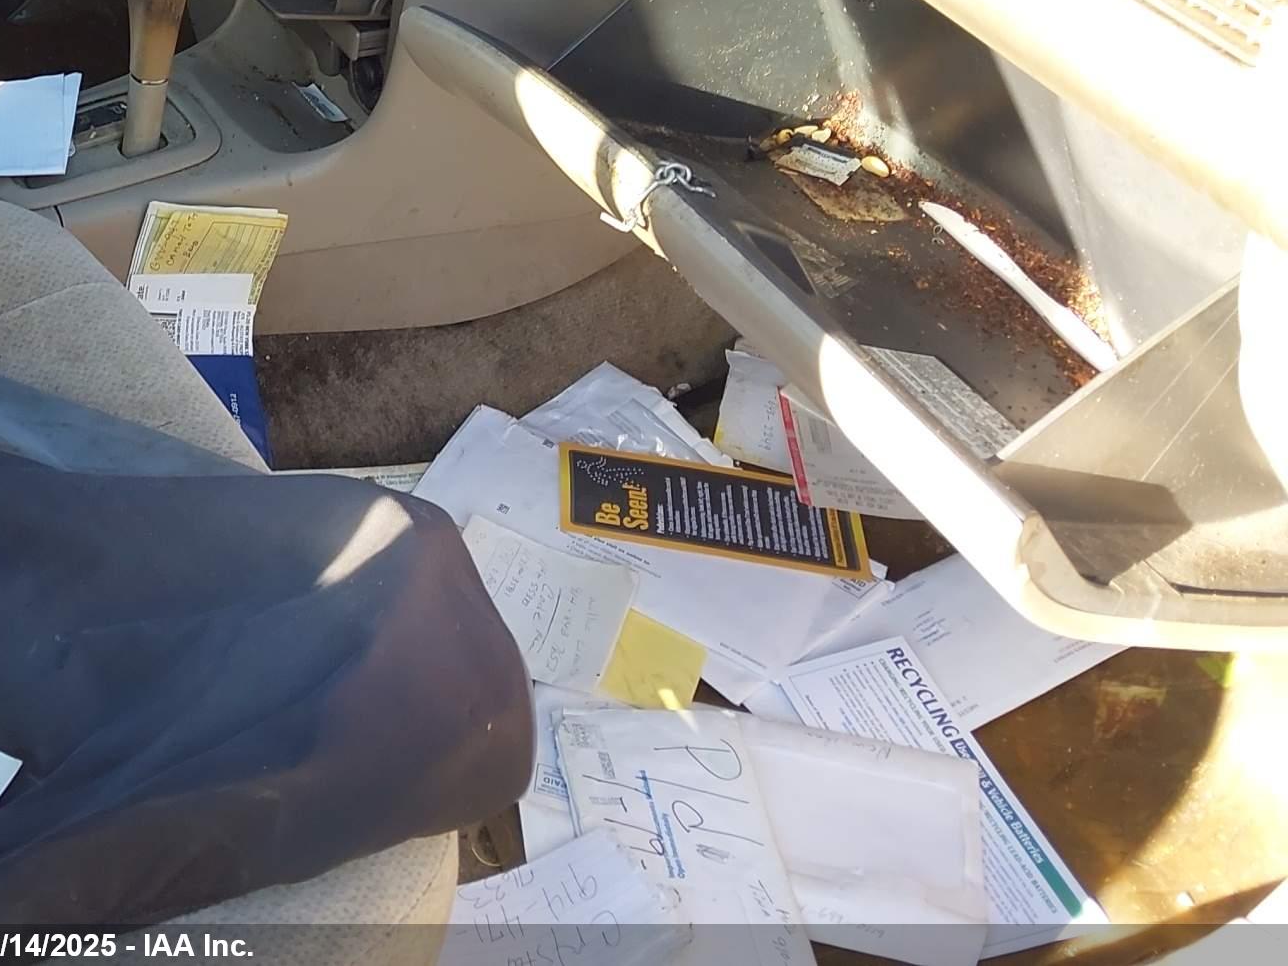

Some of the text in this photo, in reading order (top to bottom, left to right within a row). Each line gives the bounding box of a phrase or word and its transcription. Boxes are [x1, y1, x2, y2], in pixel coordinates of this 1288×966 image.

[595, 501, 622, 524] Be
[621, 483, 649, 528] Seen!
[885, 643, 961, 742] RECYCLING
[980, 777, 992, 789] &
[987, 786, 1015, 822] Vehicle
[1009, 818, 1046, 865] Batteries
